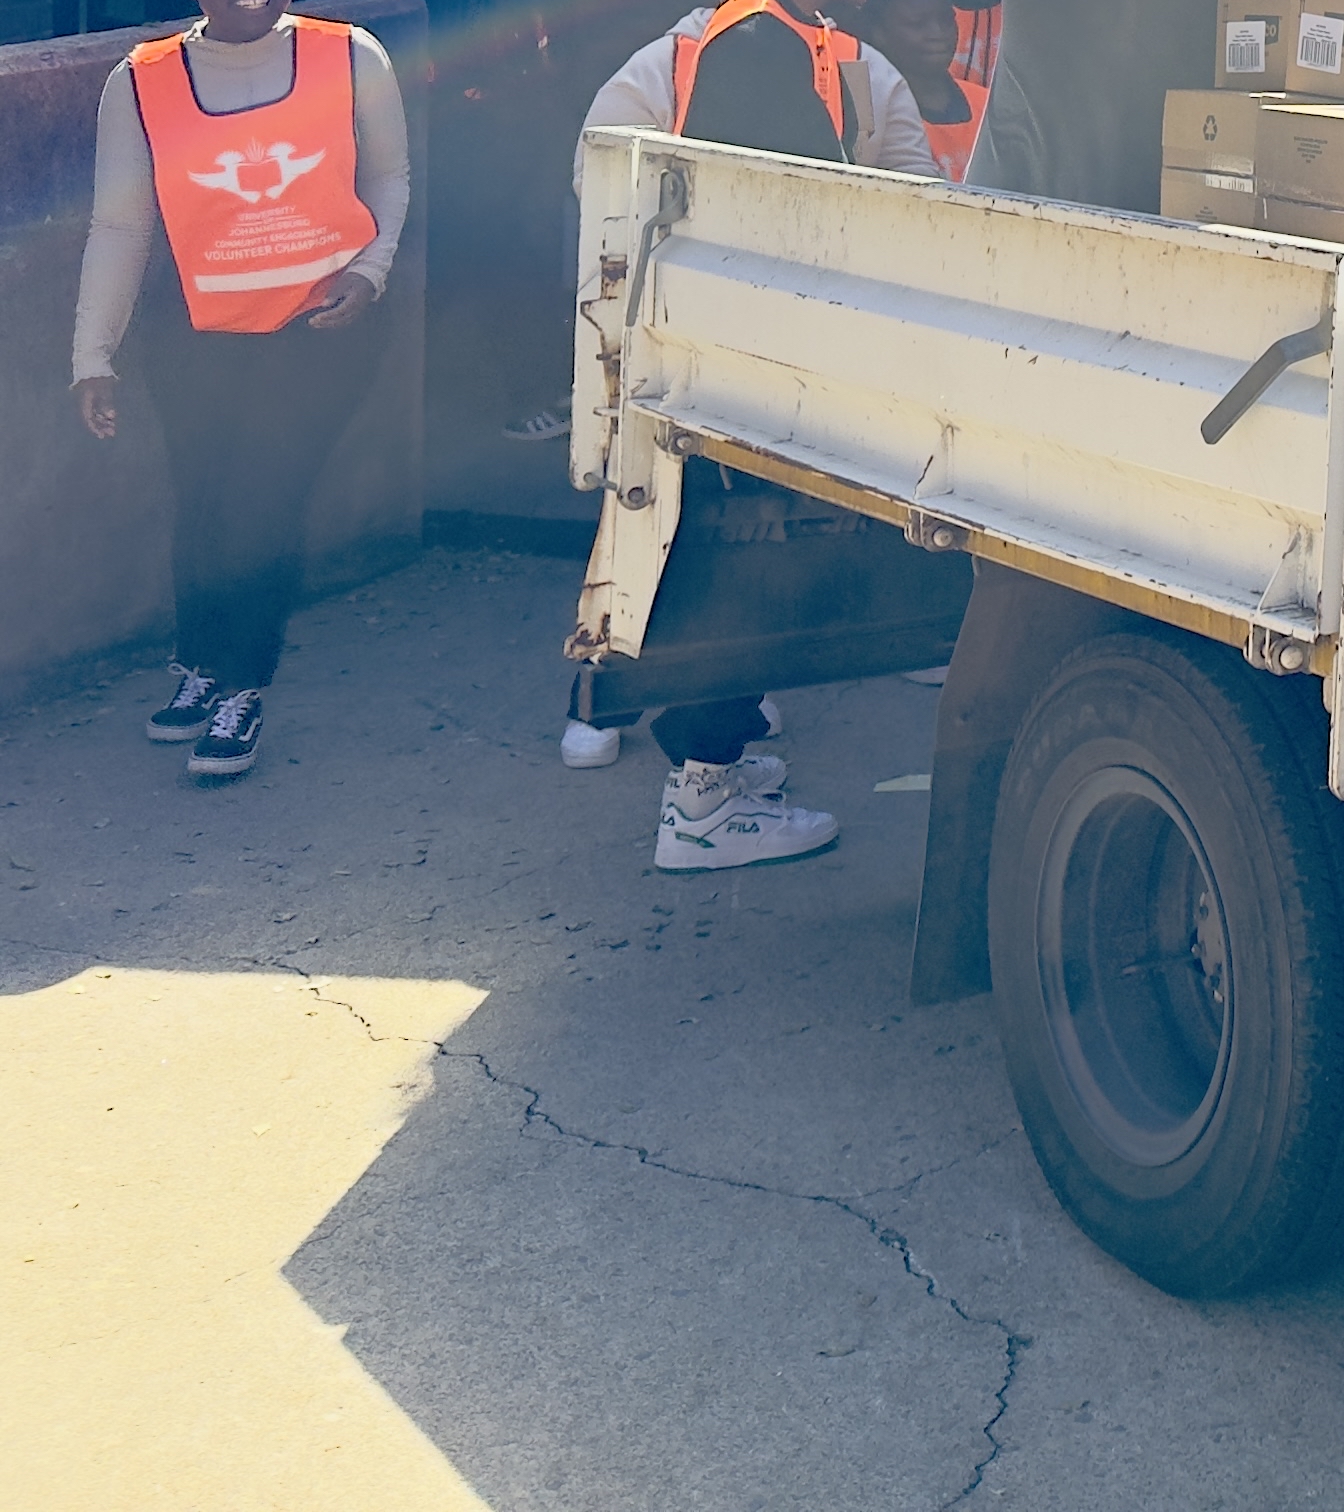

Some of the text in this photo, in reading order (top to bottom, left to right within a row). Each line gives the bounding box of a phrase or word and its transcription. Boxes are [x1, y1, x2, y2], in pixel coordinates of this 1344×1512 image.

[204, 231, 342, 261] VOLUNTEER CHAMPIONS
[215, 236, 268, 248] COMMUNITY
[726, 821, 760, 833] FILA
